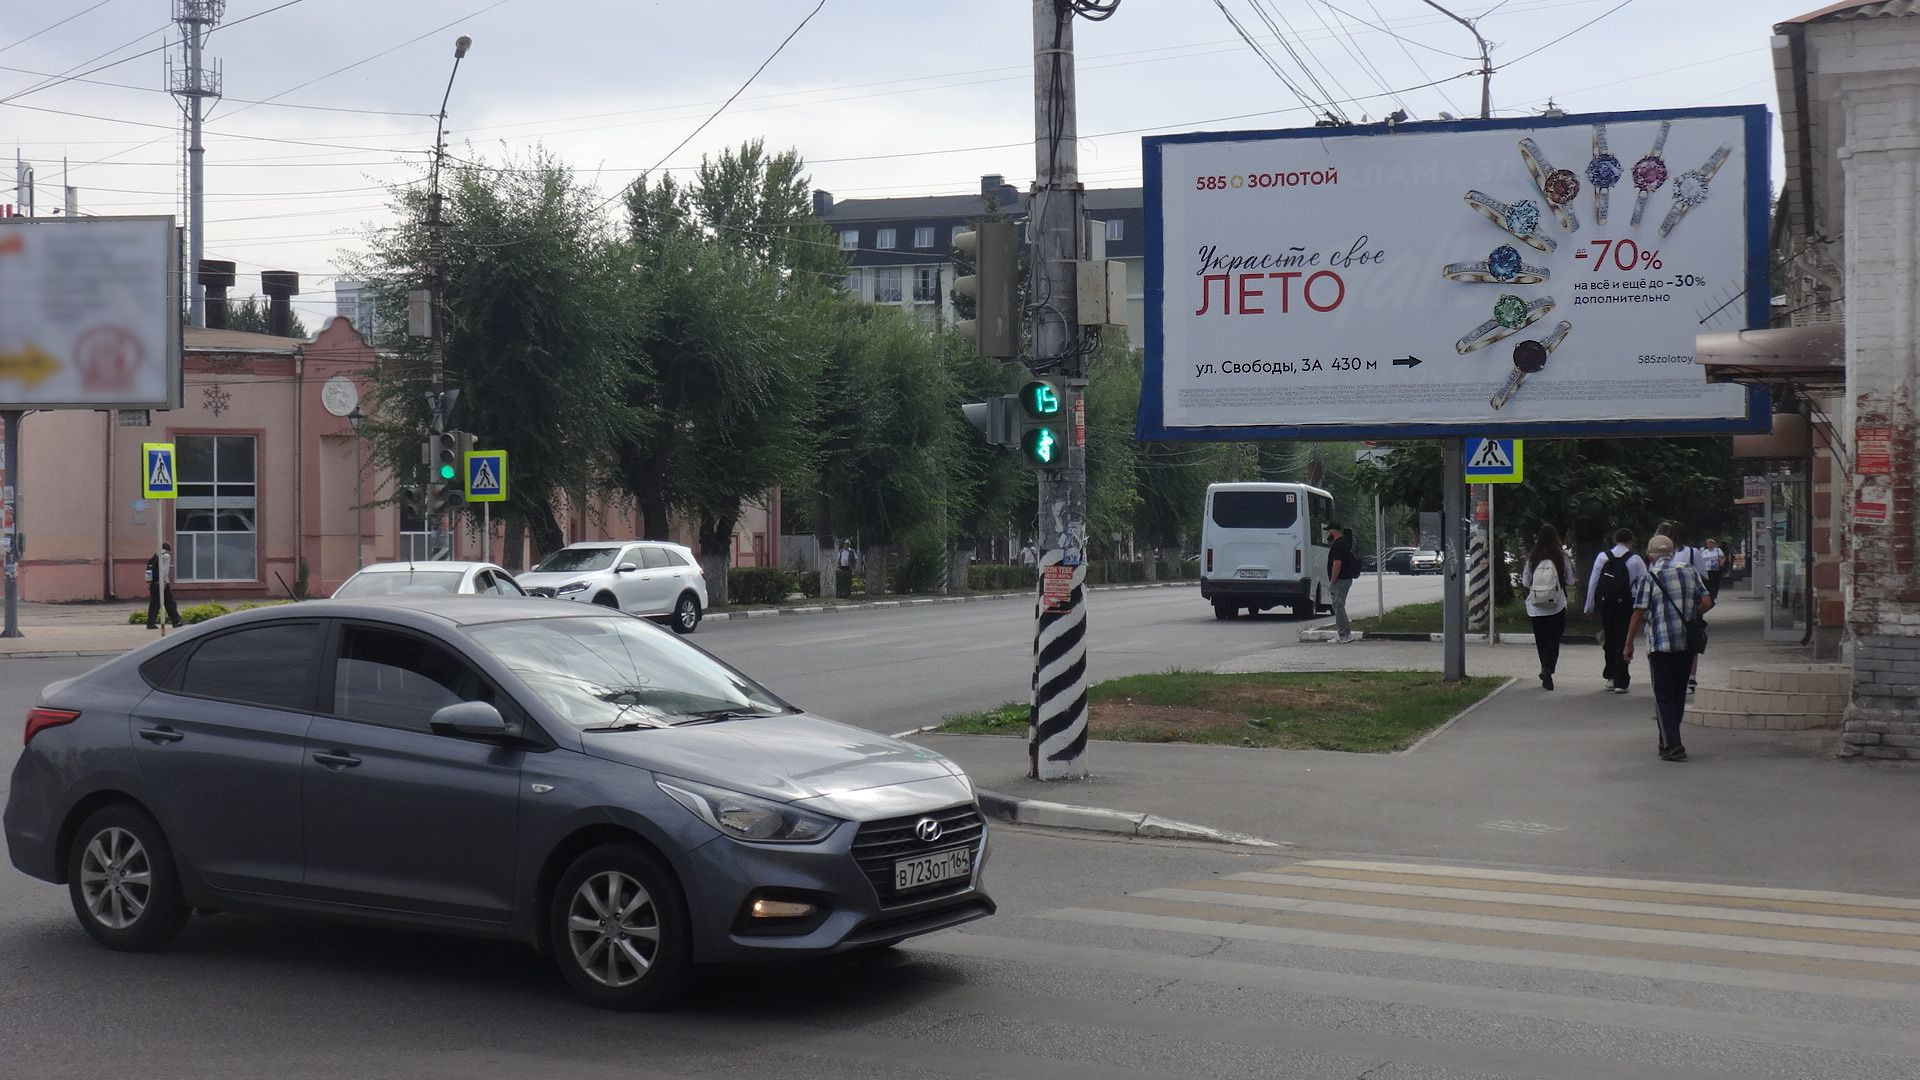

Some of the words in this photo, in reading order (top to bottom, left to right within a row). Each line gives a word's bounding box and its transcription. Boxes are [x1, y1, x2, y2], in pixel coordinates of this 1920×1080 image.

[1196, 175, 1227, 190] 585
[1247, 167, 1338, 188] ЗОЛОТОЙ
[1196, 245, 1321, 276] Украсьте
[1330, 235, 1385, 268] свое
[1575, 238, 1663, 272] -70%
[1195, 270, 1346, 316] ЛЕТО
[1574, 282, 1588, 290] на
[1590, 279, 1610, 290] всё
[1612, 281, 1620, 289] и
[1622, 278, 1647, 290] ещё
[1648, 280, 1664, 290] до
[1574, 293, 1671, 305] дополнительно
[1195, 362, 1217, 378] ул.
[1221, 359, 1298, 375] Свободы,
[1301, 358, 1323, 372] 3А
[1331, 357, 1362, 371] 430
[1366, 360, 1377, 370] м
[1035, 385, 1058, 413] 15
